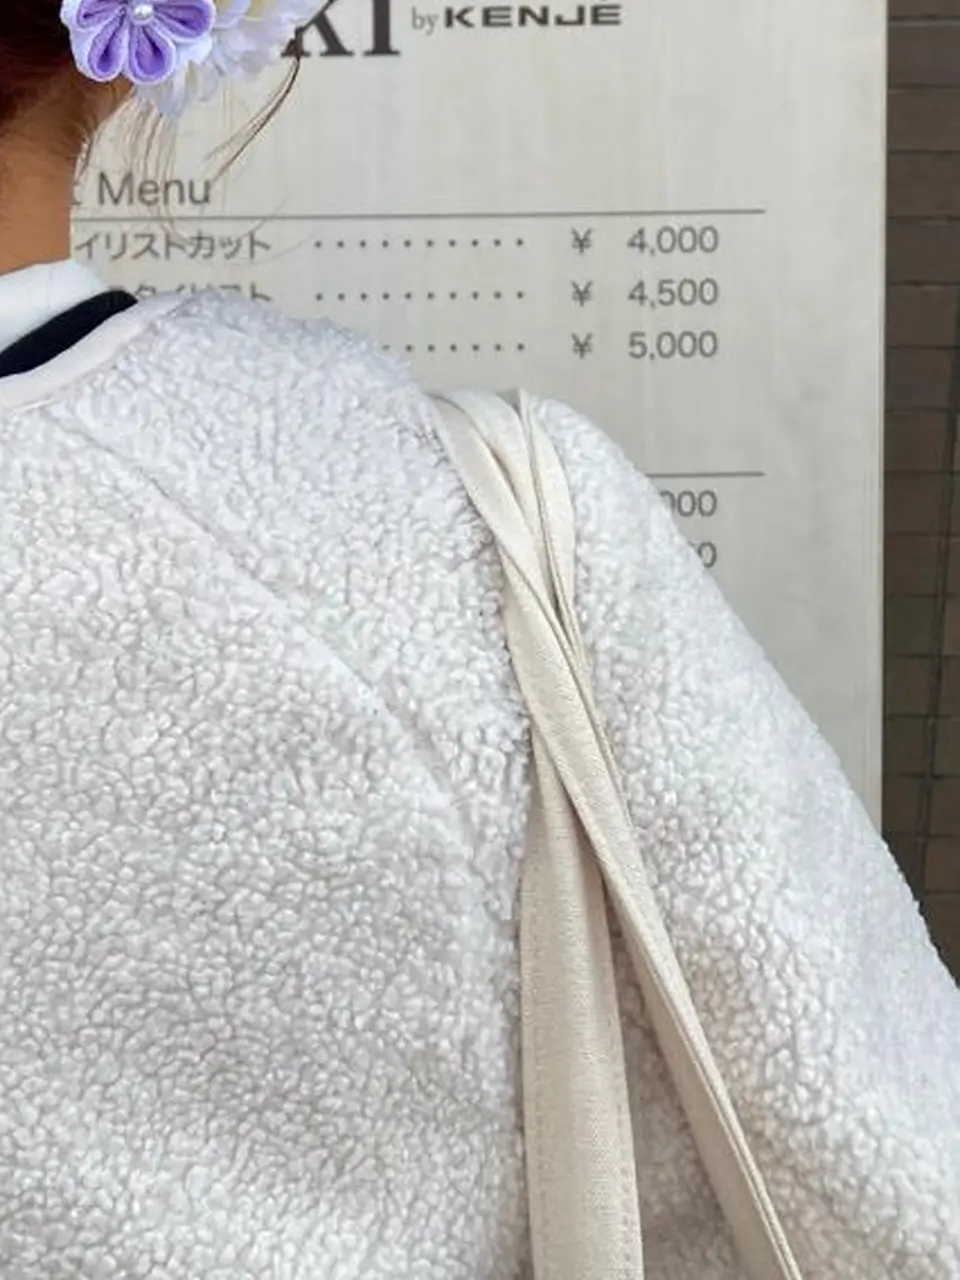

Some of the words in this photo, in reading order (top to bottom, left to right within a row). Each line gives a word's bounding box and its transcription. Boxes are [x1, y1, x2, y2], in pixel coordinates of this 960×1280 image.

[411, 6, 439, 36] by
[98, 171, 212, 206] Menu
[571, 227, 593, 255] ¥
[626, 225, 719, 257] 4,000
[571, 280, 593, 307] ¥
[627, 277, 719, 310] 4,500
[571, 332, 593, 360] ¥
[627, 330, 719, 361] 5,000
